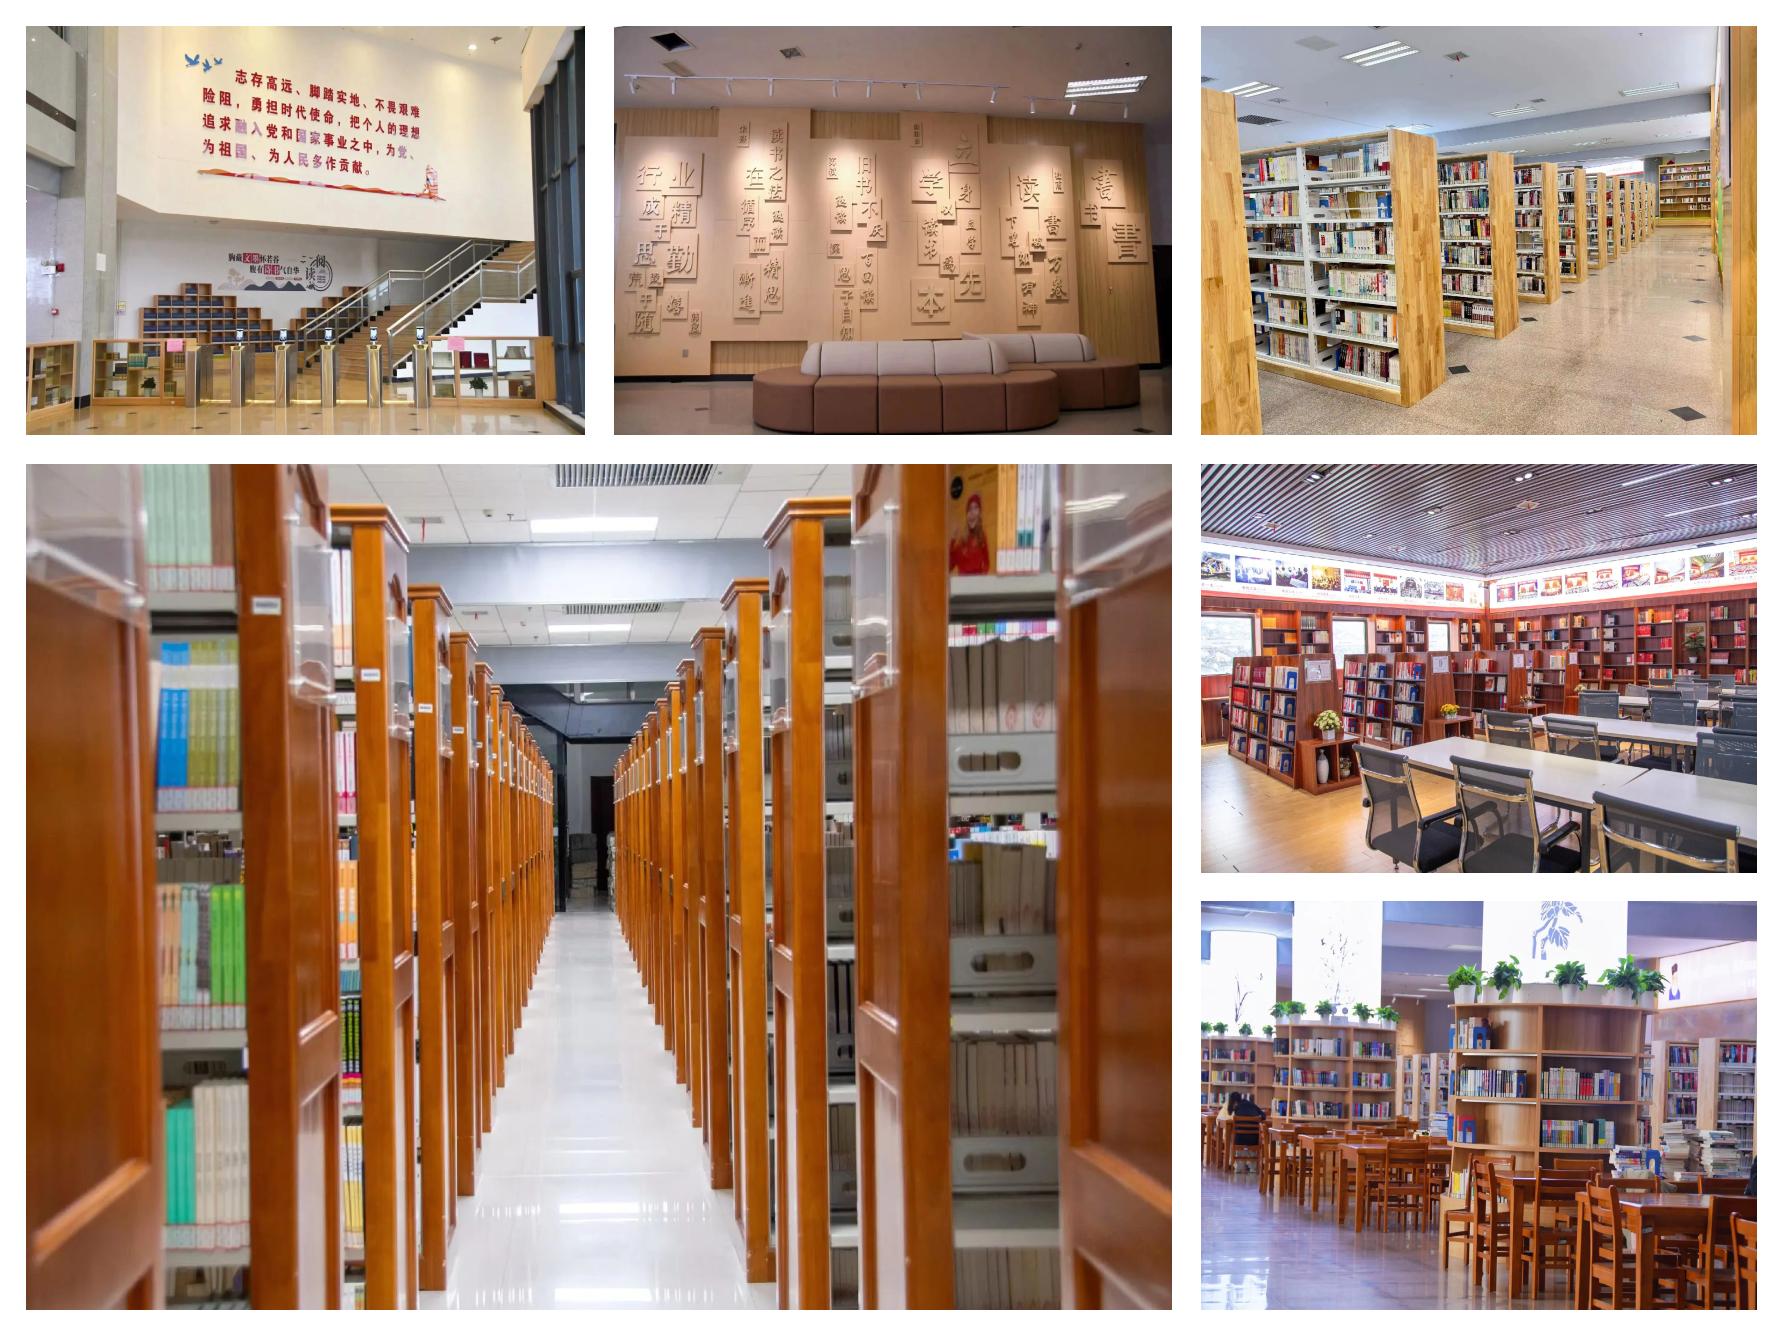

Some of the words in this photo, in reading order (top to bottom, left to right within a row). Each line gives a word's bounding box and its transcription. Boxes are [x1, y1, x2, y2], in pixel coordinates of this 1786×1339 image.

[235, 69, 420, 119] 志存高远、脚踏实地、不畏艰难
[203, 87, 420, 140] 险阻，勇担时代使命，把个人的理想
[636, 164, 663, 187] 行
[669, 160, 695, 189] 业
[671, 201, 693, 225] 精
